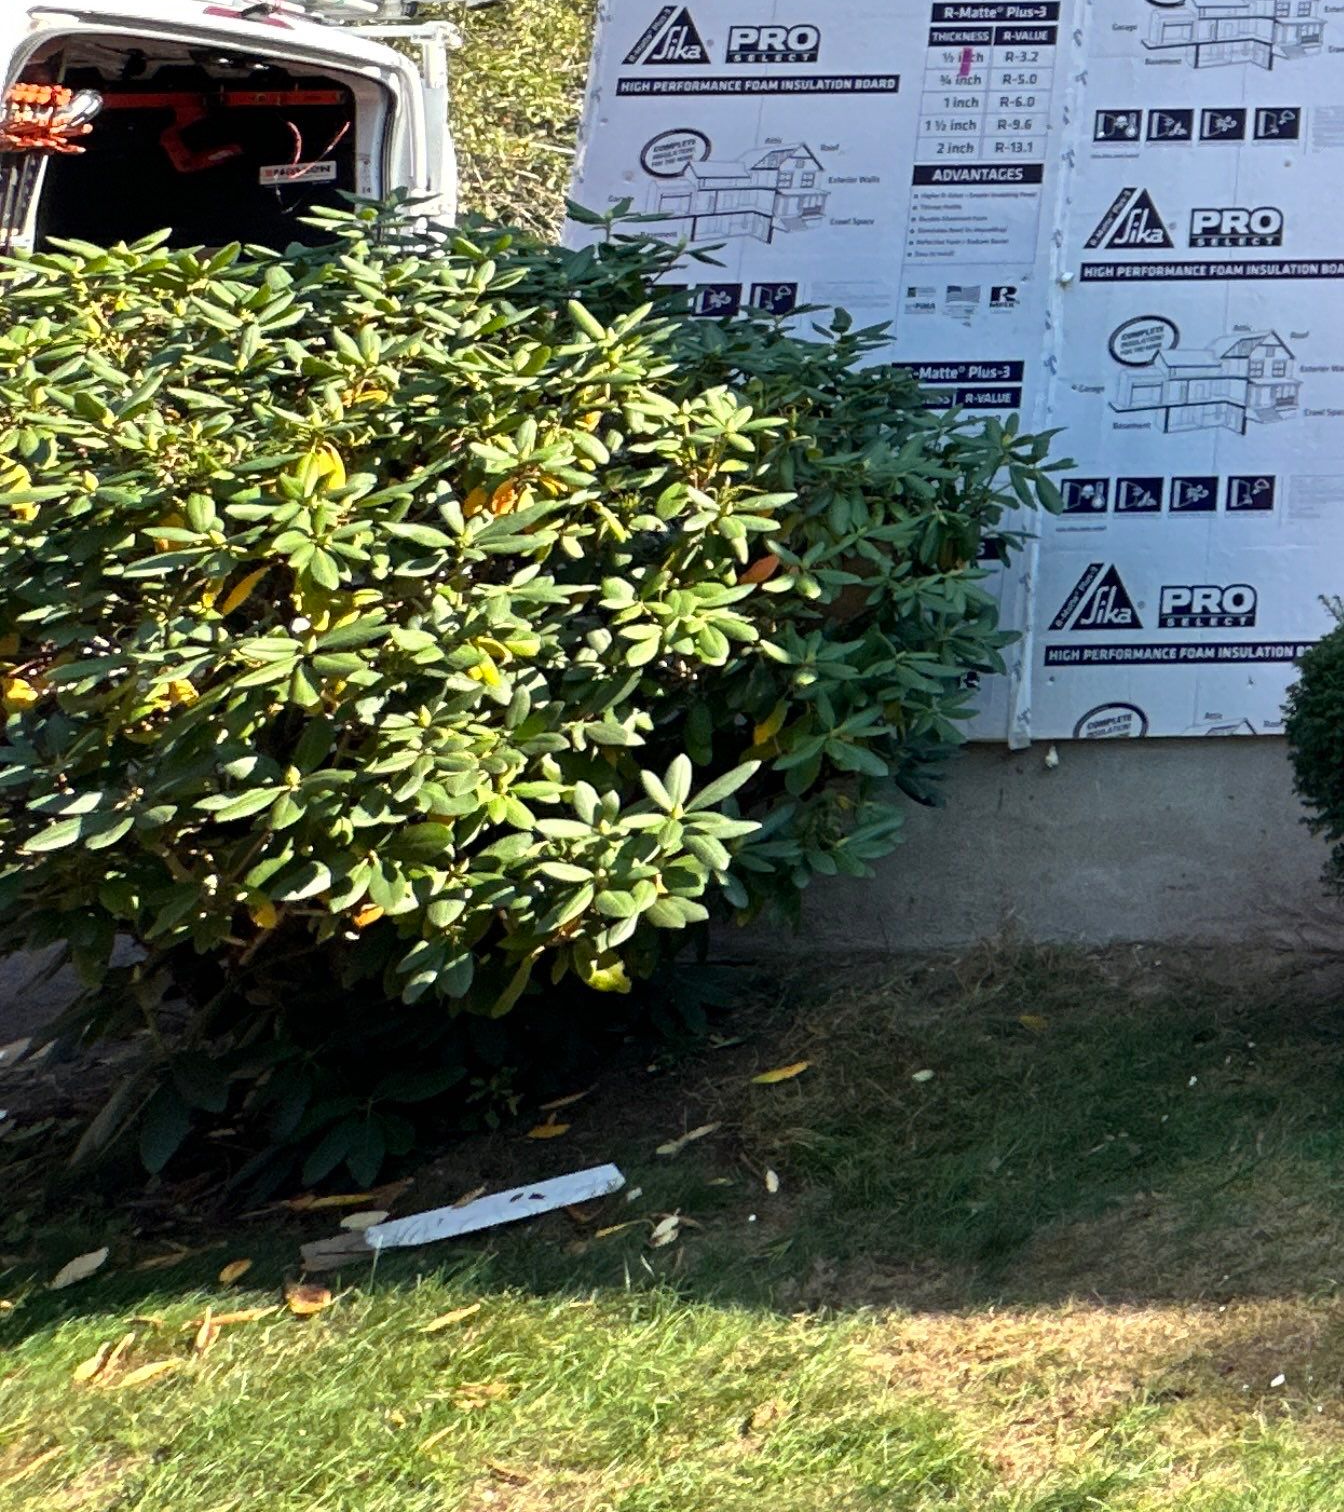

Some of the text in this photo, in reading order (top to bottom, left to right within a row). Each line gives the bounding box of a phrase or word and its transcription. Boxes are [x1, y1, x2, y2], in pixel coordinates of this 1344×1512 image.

[1006, 5, 1047, 18] Plus-3
[657, 24, 701, 60] Sika
[730, 27, 818, 51] PRO
[932, 30, 1048, 41] THICKNESS R-VALUE
[734, 54, 809, 62] SELECT
[620, 78, 896, 92] HIGH PERFORMANCE FOAM INSULATION BOARD
[931, 167, 1023, 181] ADVANTAGES
[1080, 586, 1132, 624] Sika
[1162, 587, 1255, 614] PRO
[1168, 617, 1246, 626] SELECT
